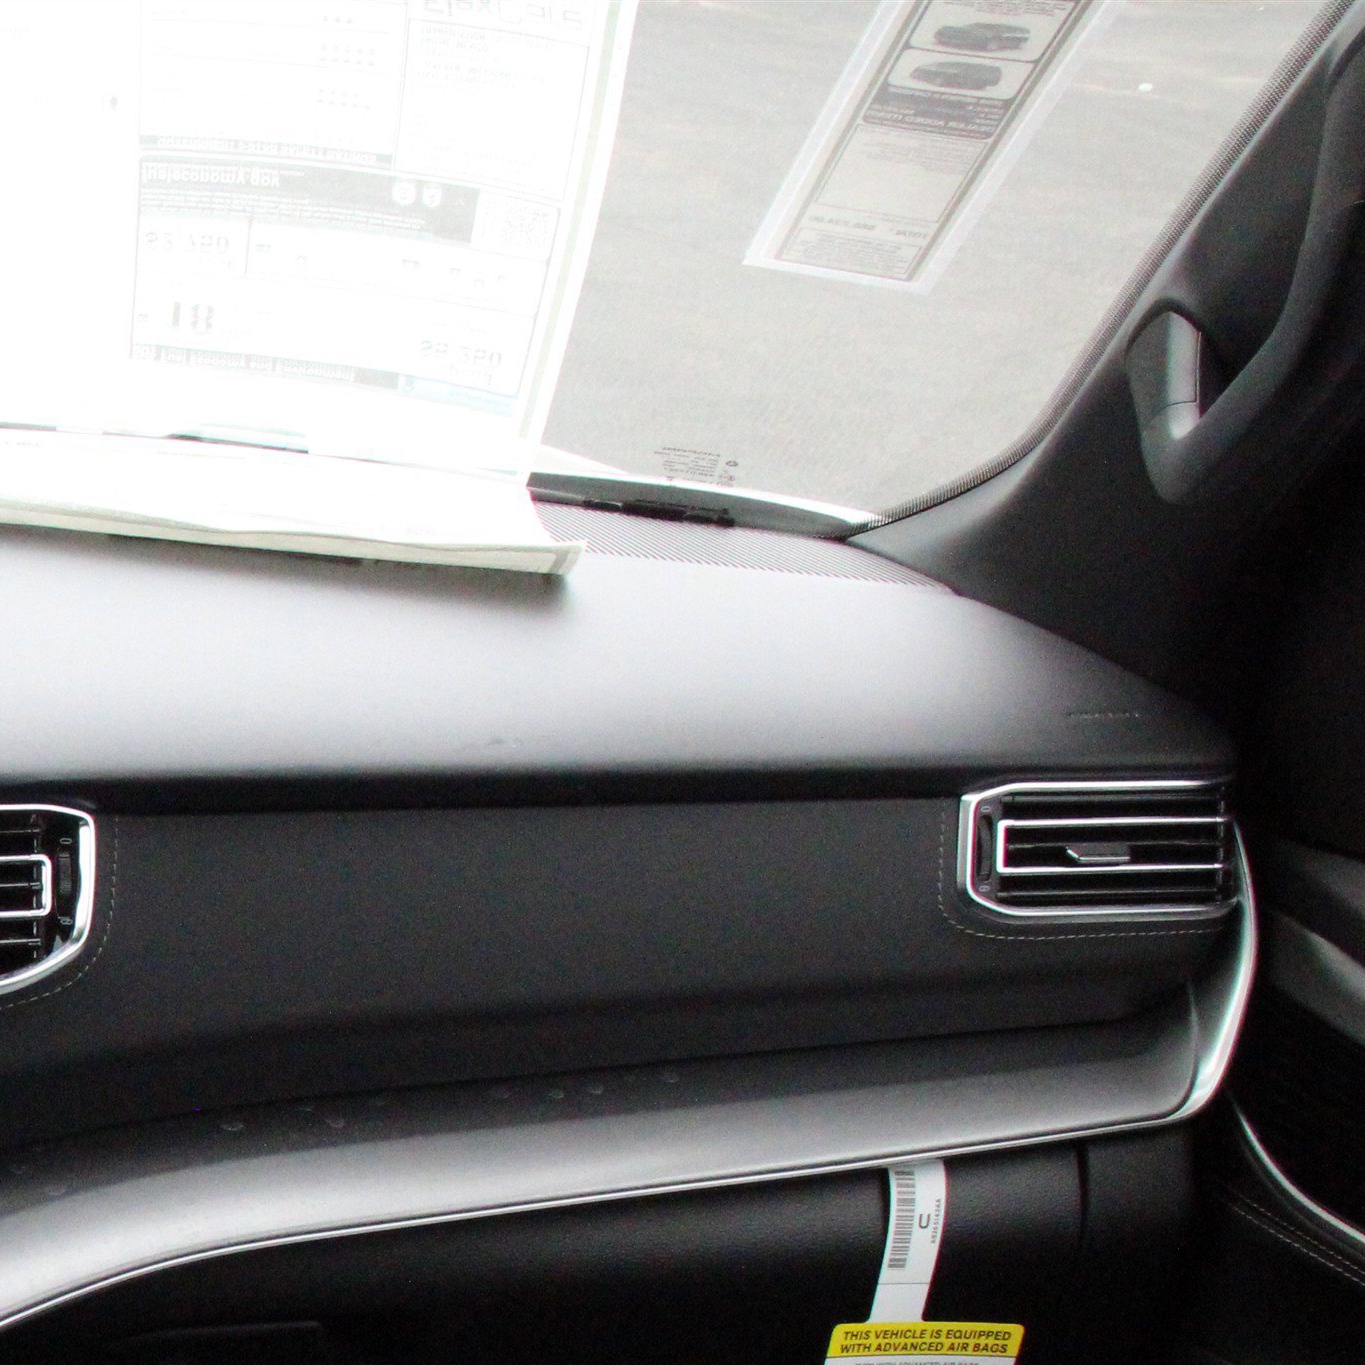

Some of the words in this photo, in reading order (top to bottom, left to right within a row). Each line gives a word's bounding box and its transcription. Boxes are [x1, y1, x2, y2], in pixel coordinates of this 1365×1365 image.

[919, 1213, 931, 1229] U
[843, 1330, 871, 1341] THIS
[874, 1329, 927, 1339] VEHICLE
[930, 1329, 942, 1339] IS
[945, 1329, 1012, 1341] EQUIPPED
[840, 1343, 869, 1354] WITH
[874, 1342, 944, 1353] ADVANCED
[947, 1342, 968, 1352] AIR
[972, 1343, 1008, 1354] BAGS
